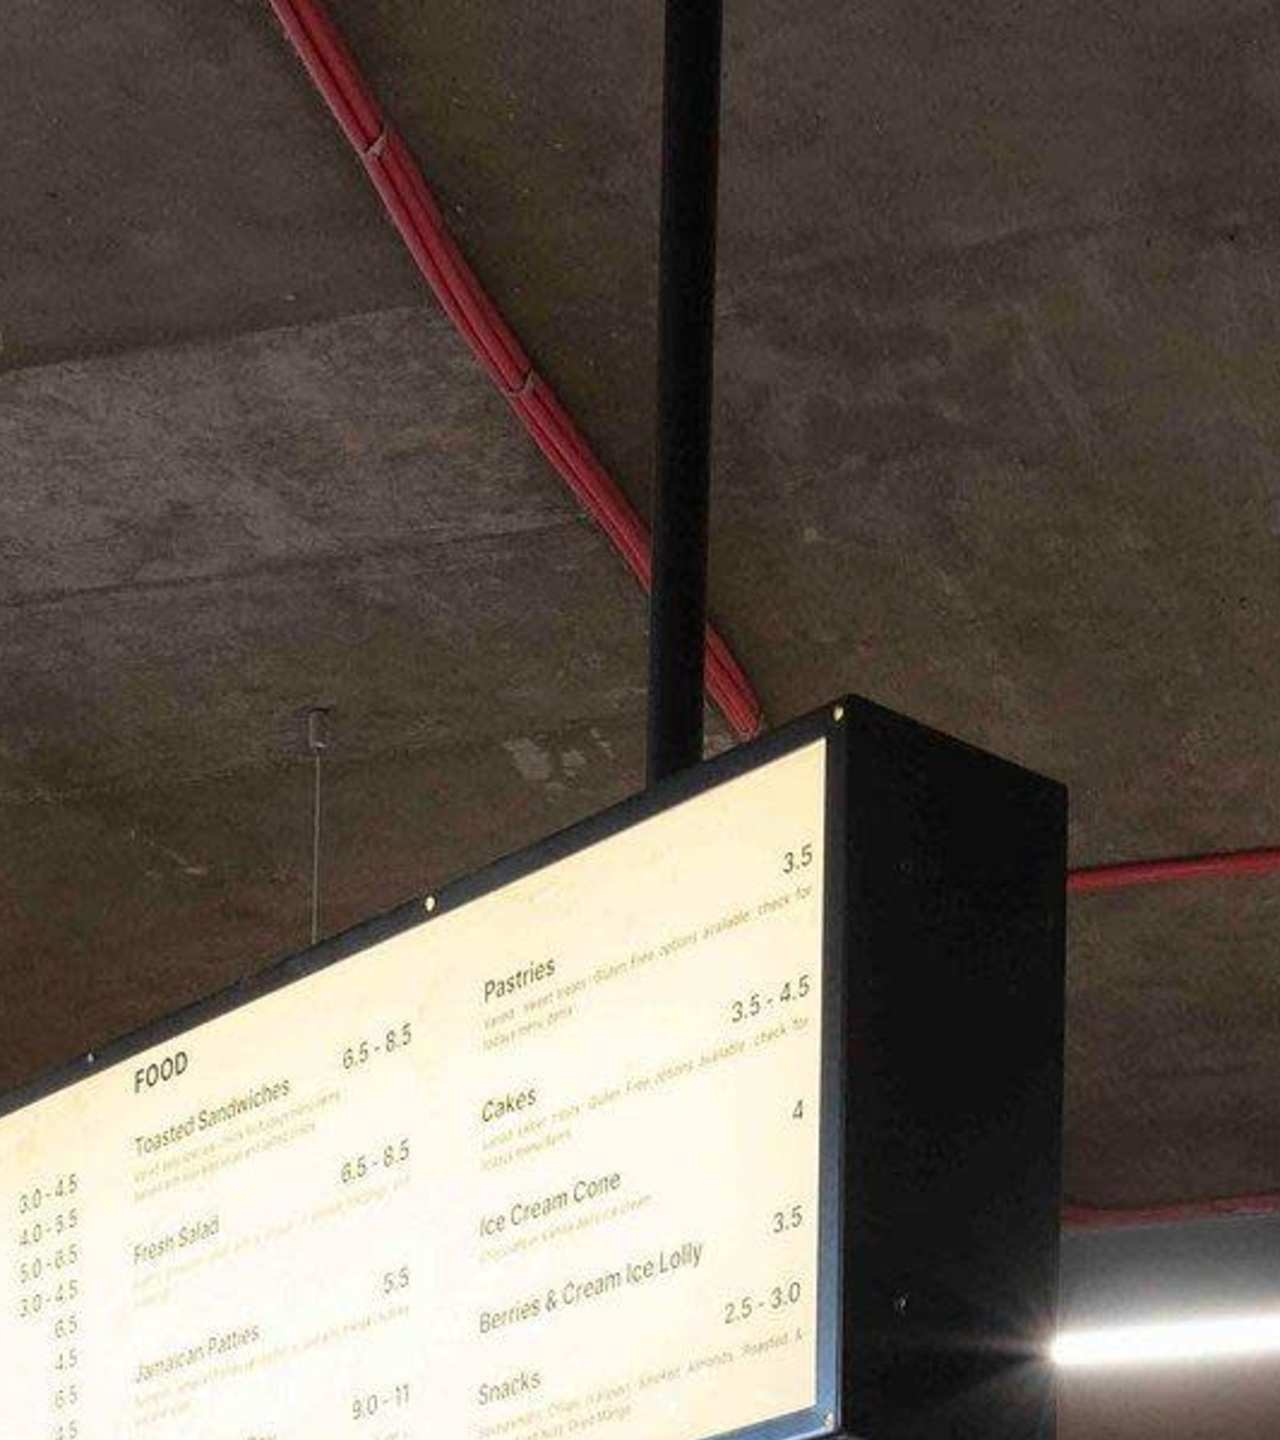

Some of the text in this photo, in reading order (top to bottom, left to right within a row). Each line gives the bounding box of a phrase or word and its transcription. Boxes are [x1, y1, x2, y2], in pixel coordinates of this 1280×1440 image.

[783, 843, 813, 875] 3.5
[484, 959, 556, 1003] Pastries
[731, 993, 761, 1024] 3.5
[779, 974, 810, 1002] 4.5
[342, 1040, 369, 1070] 6.5
[385, 1022, 412, 1053] 8.5
[134, 1051, 188, 1094] FOOD
[134, 1115, 195, 1154] Toasted
[197, 1079, 290, 1132] Sandwiches
[481, 1088, 536, 1123] Cakes
[792, 1099, 804, 1120] 4
[341, 1155, 369, 1184] 6.5
[383, 1138, 410, 1168] 8.5
[479, 1214, 506, 1237] Ice
[510, 1191, 568, 1226] Cream
[572, 1172, 621, 1204] Cone
[773, 1204, 803, 1234] 3.5
[133, 1236, 175, 1265] Fresh
[177, 1215, 220, 1248] Salad
[383, 1266, 410, 1295] 5.5
[479, 1242, 703, 1334] Berries & Cream Ice Lolly
[724, 1296, 753, 1325] 2.5
[771, 1281, 802, 1310] 3.0
[135, 1345, 205, 1384] Jamaican
[207, 1325, 260, 1355] Patties
[478, 1371, 542, 1406] Snacks
